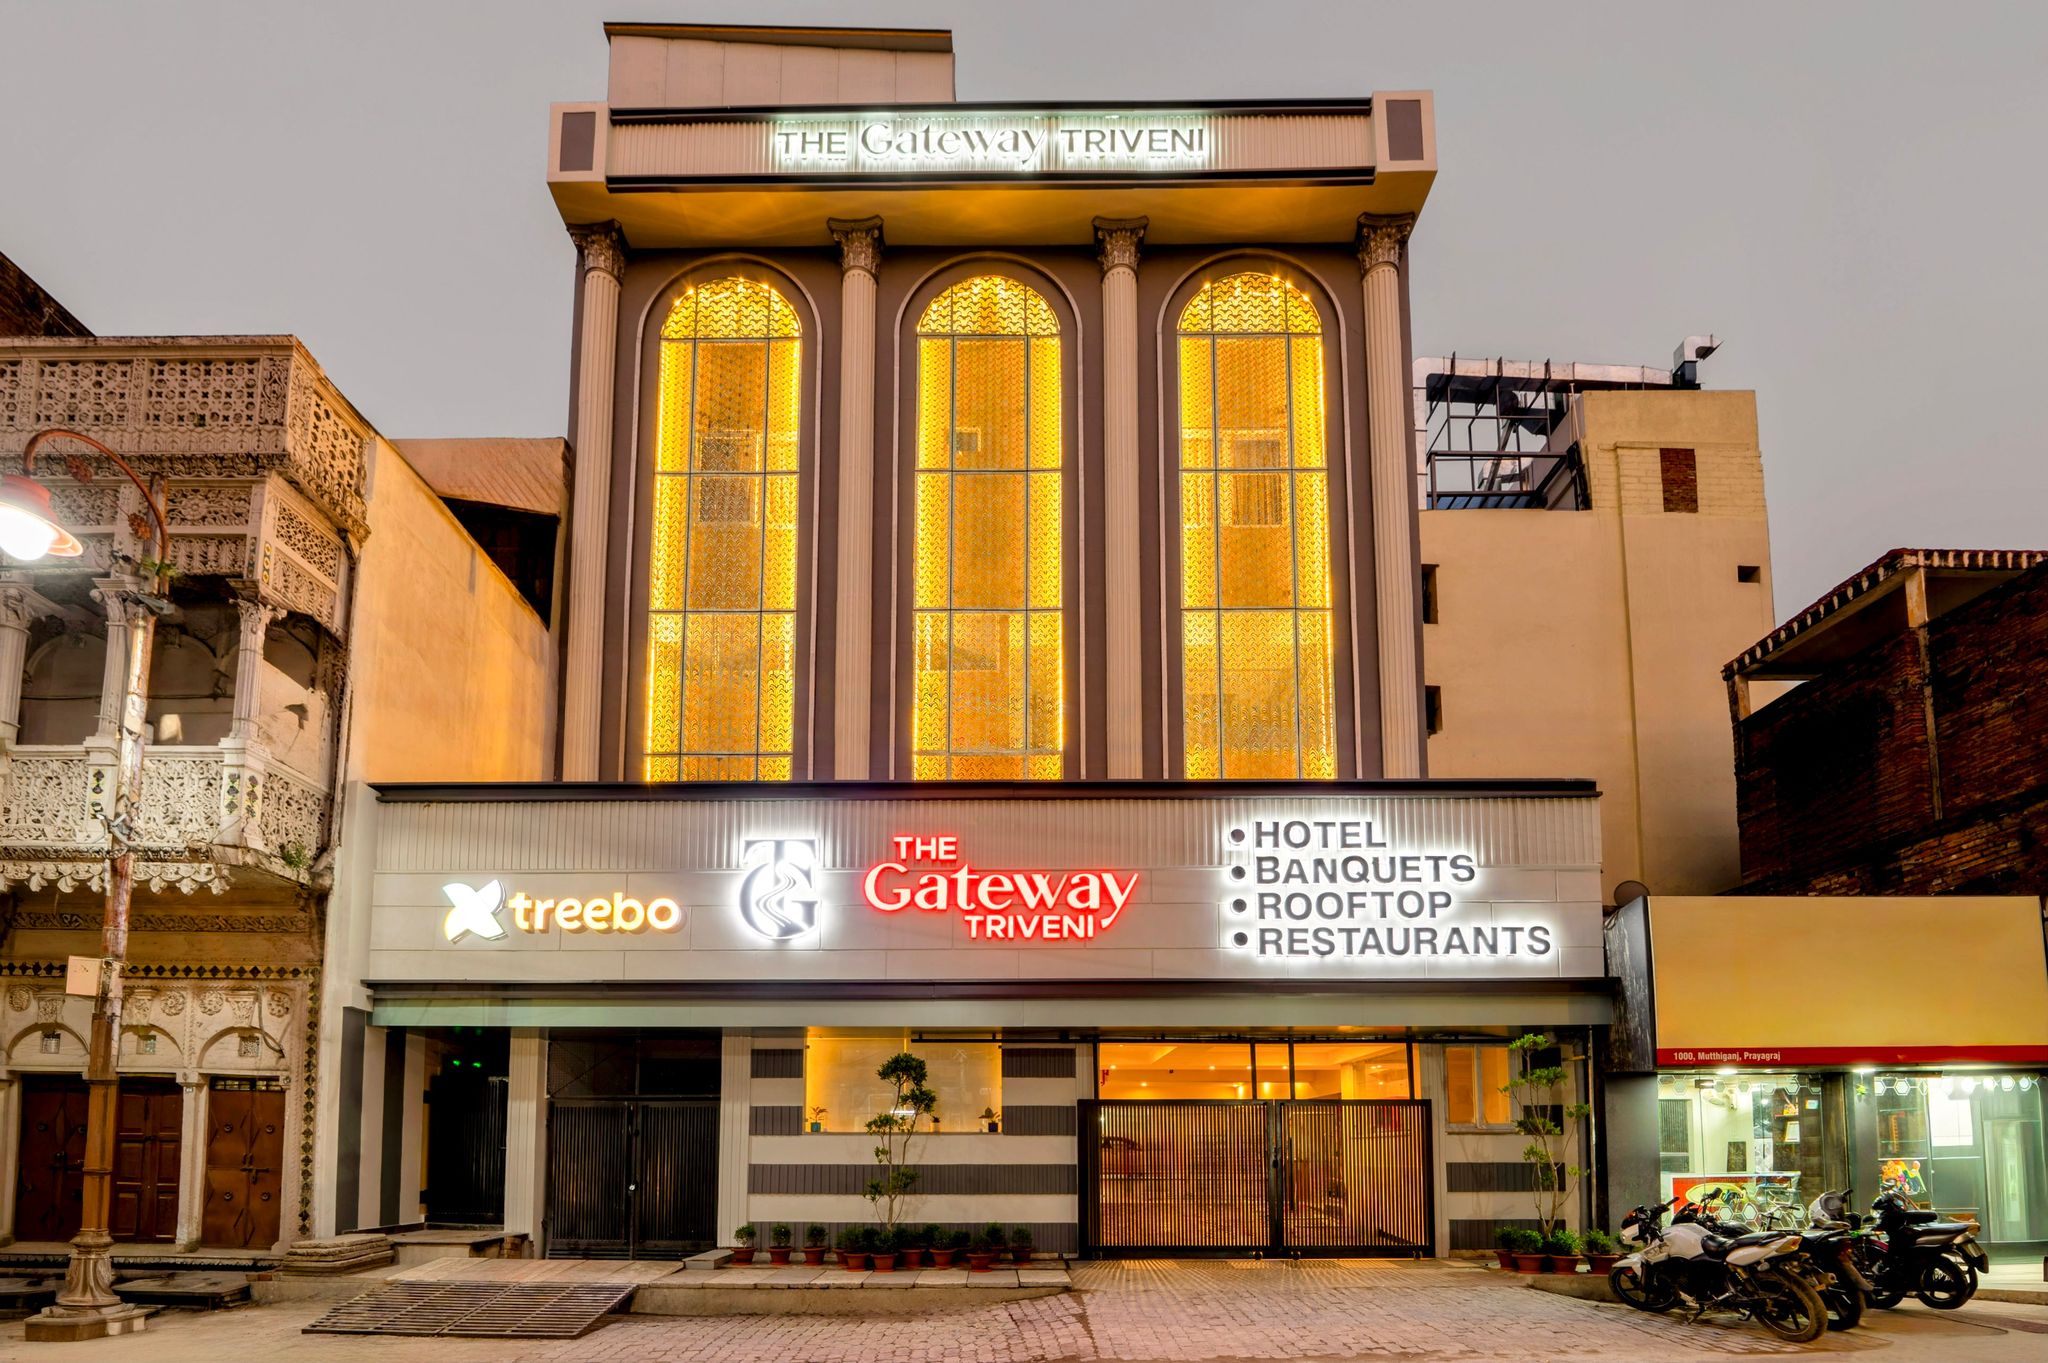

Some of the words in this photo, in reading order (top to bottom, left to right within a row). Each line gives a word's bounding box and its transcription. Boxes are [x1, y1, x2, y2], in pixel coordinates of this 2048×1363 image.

[777, 130, 847, 155] THE
[860, 122, 1046, 165] Gateway
[1061, 128, 1204, 154] TRIVENI
[893, 836, 957, 860] THE
[1254, 820, 1387, 848] HOTEL
[1255, 854, 1476, 884] BANQUETS
[864, 862, 1139, 929] Gateway
[1257, 890, 1453, 920] ROOFTOP
[508, 892, 681, 931] treebo
[964, 915, 1094, 939] TRIVENI
[1257, 926, 1552, 956] RESTAURANTS
[1673, 1051, 1696, 1062] 1000,
[1698, 1051, 1742, 1062] Mutthiganj,
[1744, 1051, 1781, 1062] Prayagraj
